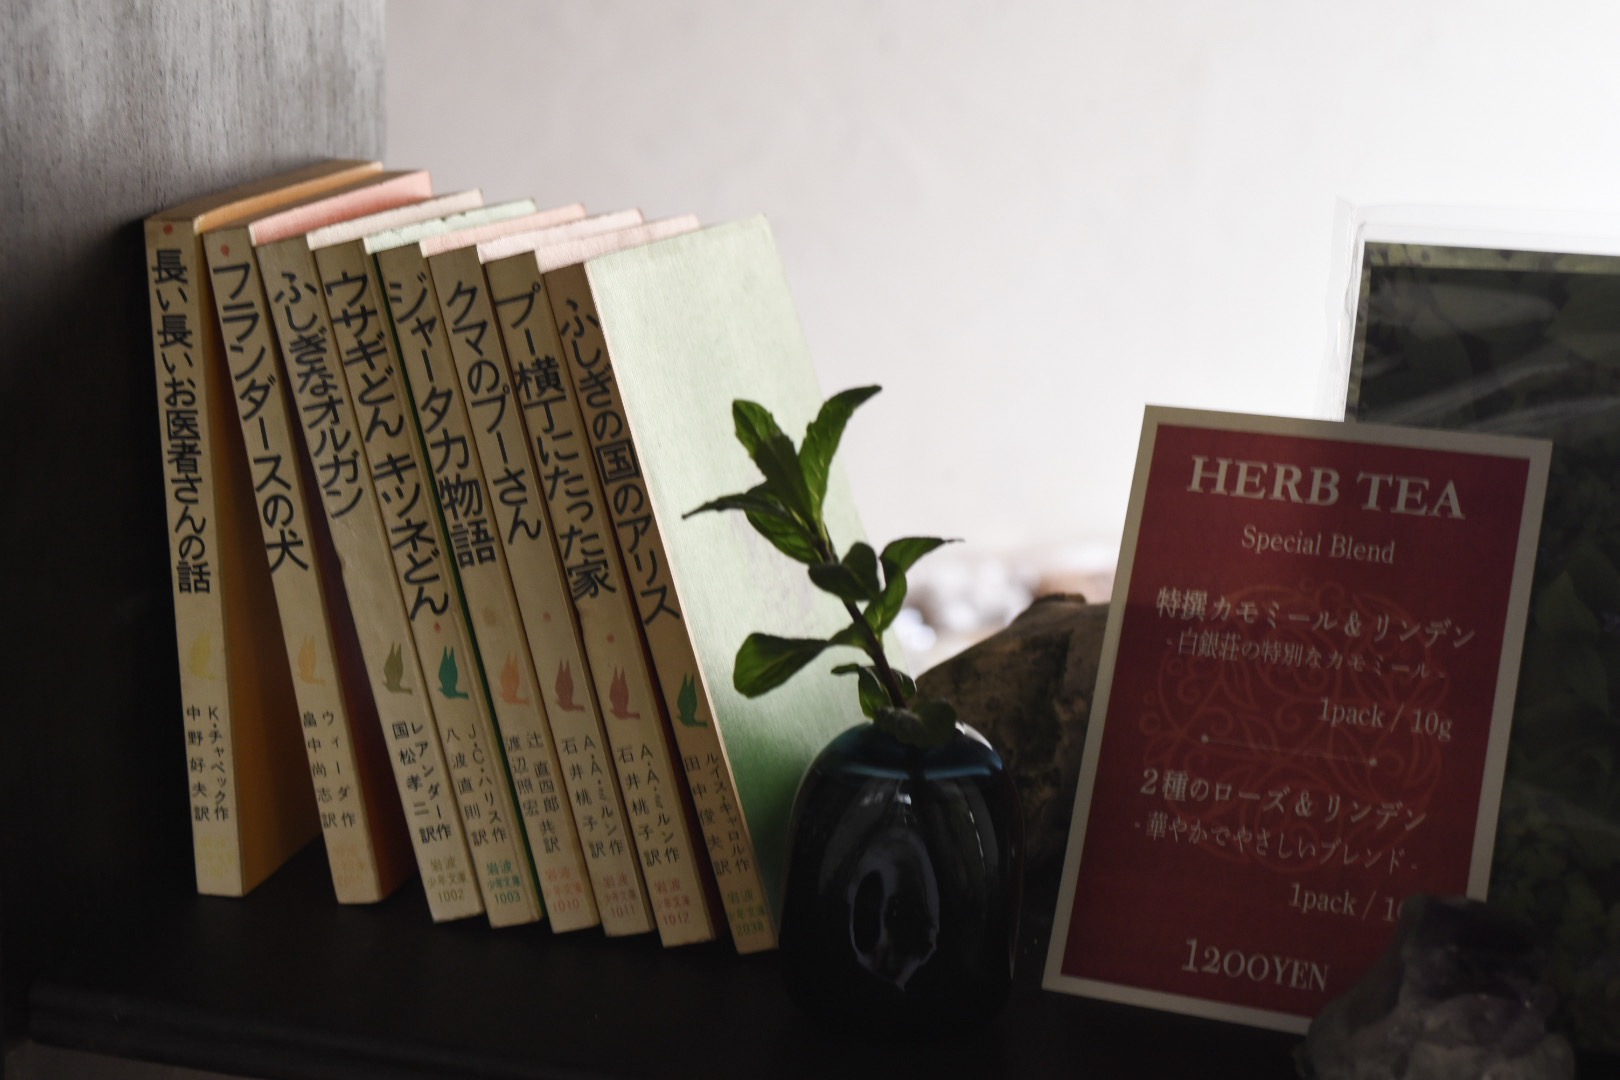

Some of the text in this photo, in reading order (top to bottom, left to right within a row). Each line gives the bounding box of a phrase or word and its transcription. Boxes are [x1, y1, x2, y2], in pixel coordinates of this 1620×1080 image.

[151, 248, 211, 594] 長い長いお医者さんの話
[213, 261, 309, 574] フランダースの犬
[274, 272, 364, 519] ふしぎなオルガン
[388, 272, 497, 569] ジャータカ物語
[447, 281, 542, 545] クマのプーさん
[495, 282, 616, 601] プー横丁にたった家
[561, 299, 681, 625] ふしぎの国のアリス
[1187, 454, 1466, 520] HERB TEA
[1241, 525, 1395, 565] Special Blend
[1317, 697, 1384, 729] 1pack
[1411, 708, 1453, 742] 10g
[561, 737, 606, 858] 石井桃子訳
[617, 745, 662, 867] 石井桃子訳
[494, 891, 521, 905] 1003
[662, 913, 690, 926] 1012
[1288, 881, 1357, 917] 1pack
[1181, 937, 1329, 993] 1200YEN
